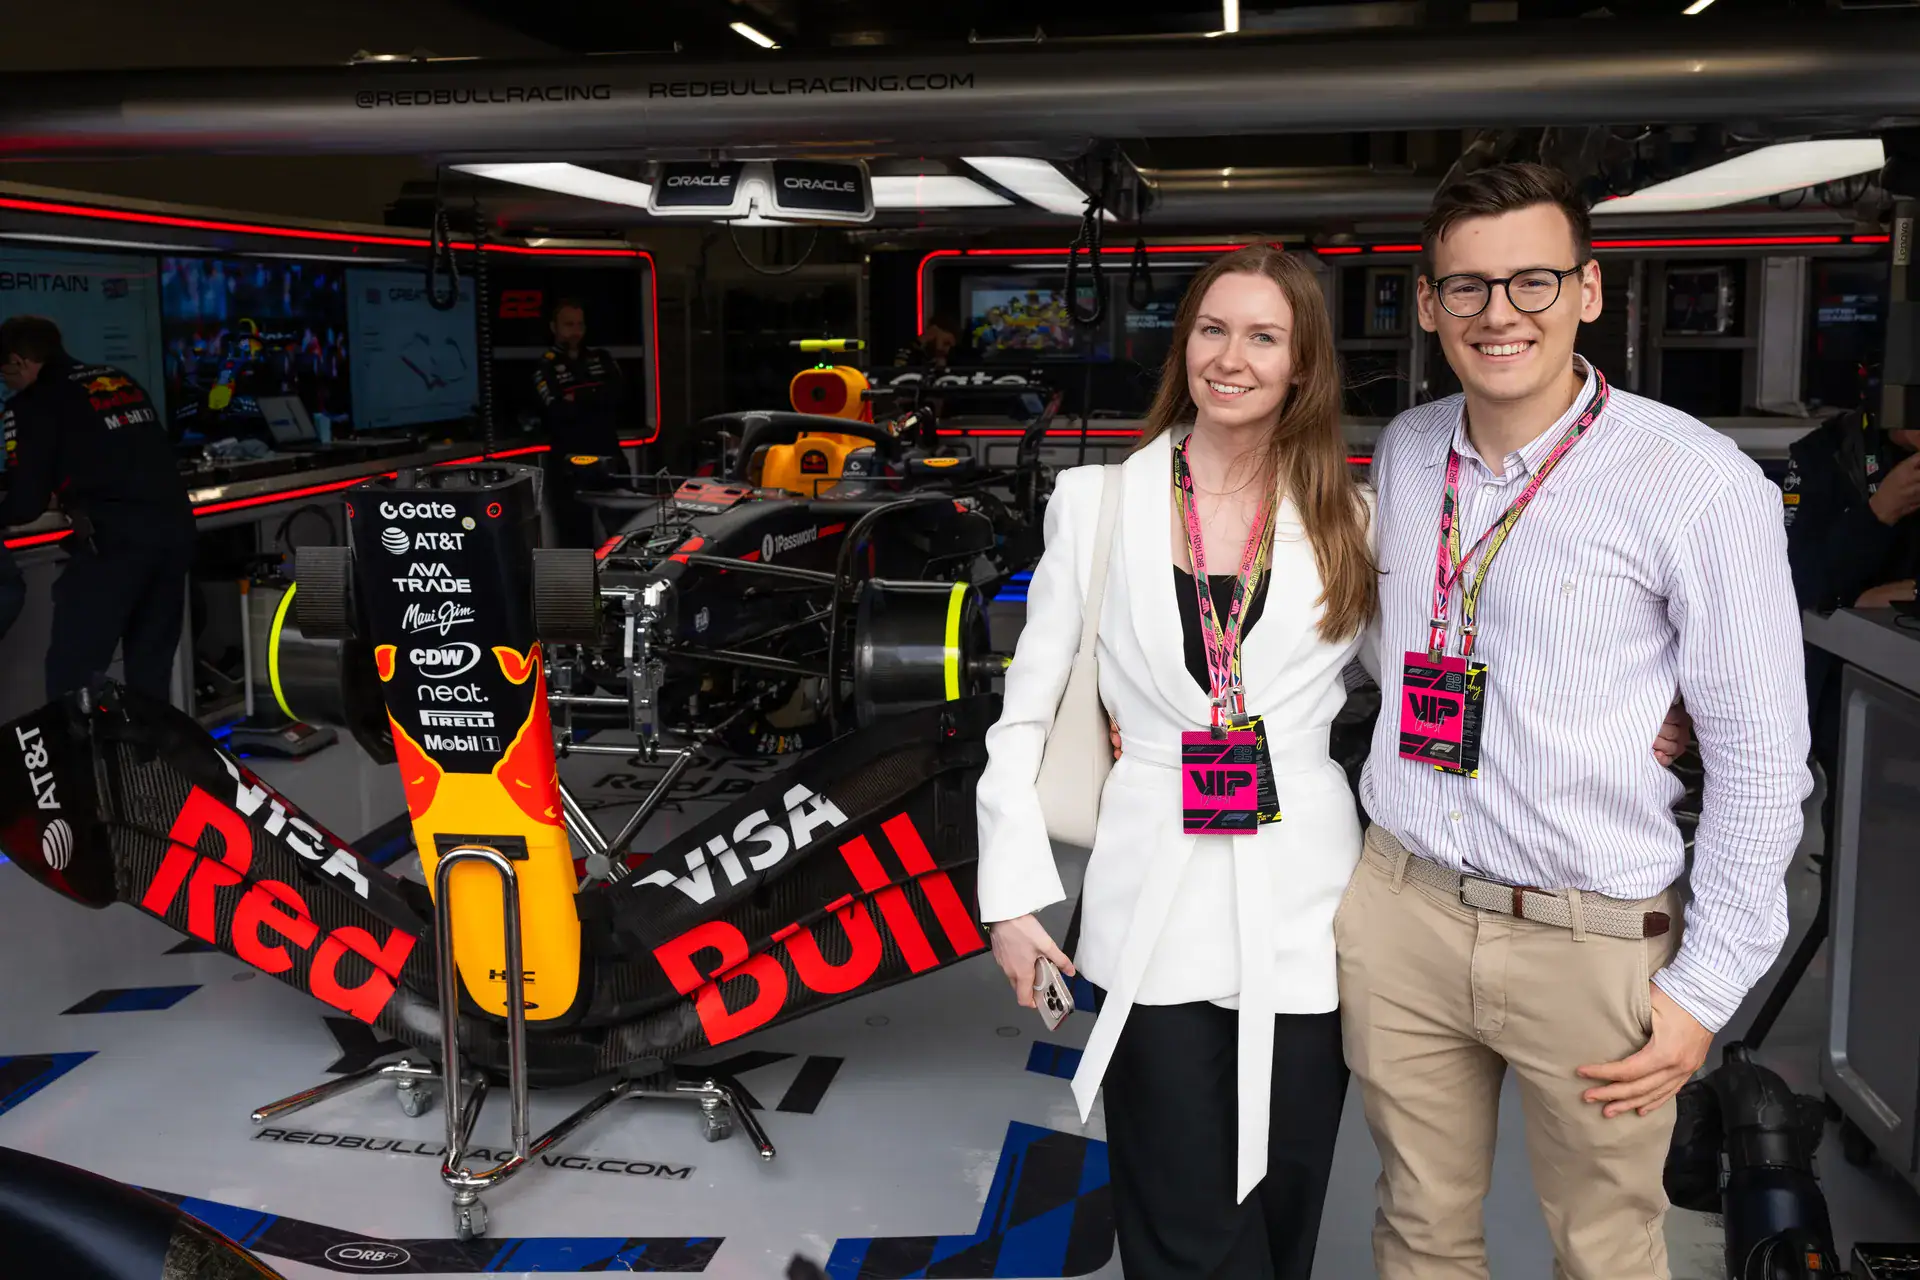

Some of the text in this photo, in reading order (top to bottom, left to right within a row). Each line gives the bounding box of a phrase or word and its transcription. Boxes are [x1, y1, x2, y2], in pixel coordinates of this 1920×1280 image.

[649, 72, 974, 98] REDBULLRACING.COM
[356, 84, 612, 109] @REDBULLRACING
[666, 175, 731, 188] ORACLE
[783, 177, 856, 192] ORACLE
[0, 272, 89, 292] BRITAIN
[1578, 412, 1594, 427] VIP
[399, 501, 456, 519] Gate
[1442, 513, 1451, 531] VIP
[414, 532, 465, 550] AT&T
[1193, 535, 1205, 568] BRITAIN
[408, 563, 452, 577] AVA
[392, 578, 472, 593] TRADE
[1201, 597, 1211, 614] VIP
[1231, 599, 1241, 615] VIP
[402, 601, 475, 636] Maui Jim
[409, 649, 464, 666] CDW
[418, 683, 489, 702] neat.
[1407, 692, 1459, 726] VIP
[419, 710, 495, 728] PIRELLI
[1415, 711, 1447, 733] Guest
[424, 734, 479, 751] Mobil
[16, 726, 61, 811] AT&T
[1189, 770, 1252, 797] VIP
[214, 748, 369, 899] VISA
[632, 783, 848, 904] VISA
[141, 784, 987, 1047] Red Bull
[489, 970, 535, 981] HC
[254, 1128, 693, 1180] REDBULLACNG.COM
